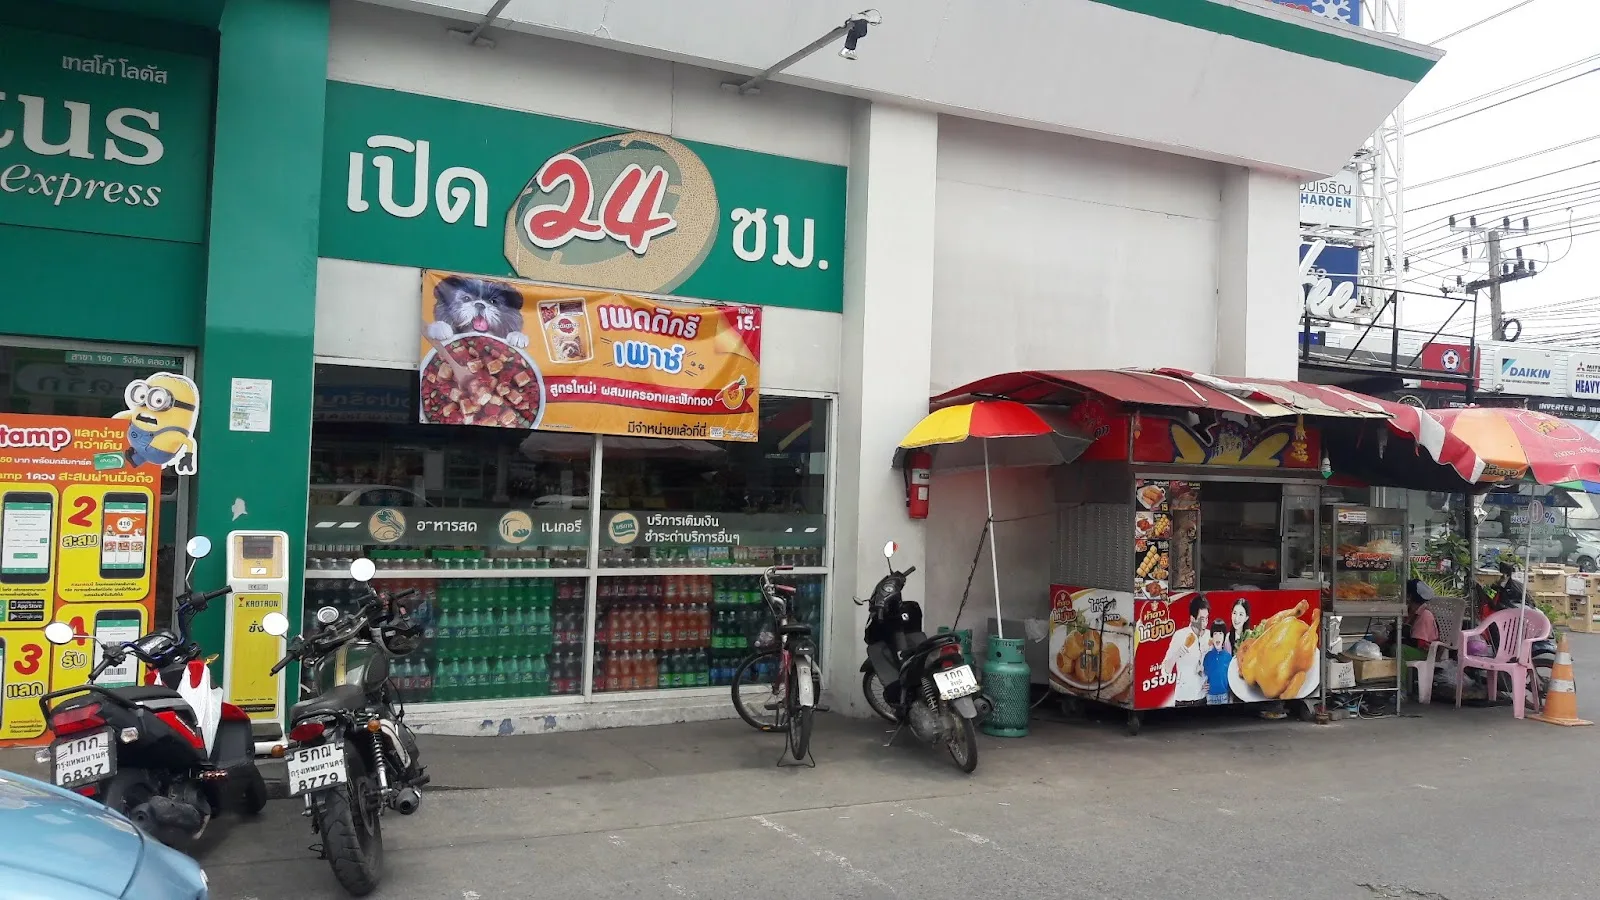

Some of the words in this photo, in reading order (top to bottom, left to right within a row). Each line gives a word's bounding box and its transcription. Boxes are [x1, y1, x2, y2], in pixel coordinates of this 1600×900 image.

[62, 54, 115, 77] เทสโก้
[119, 58, 168, 84] โลตัส
[0, 163, 162, 207] express
[347, 135, 489, 227] เปิด
[524, 153, 677, 254] 24
[730, 205, 829, 270] ชม.
[598, 305, 702, 341] เพดดิกรี
[71, 353, 93, 361] สาขา
[97, 354, 112, 363] 190
[1509, 367, 1551, 379] DAIKIN
[549, 380, 597, 398] สูตรใหม่!
[74, 427, 125, 439] แลกง่าย
[627, 421, 707, 438] มีจำหน่ายแล้วที่นี่
[73, 438, 123, 451] กว่าเดิม
[58, 471, 154, 484] สะสมผ่านมือถือ
[68, 495, 97, 528] 2
[646, 513, 720, 527] บริการเติมเงิน
[62, 534, 99, 548] สะสม
[1139, 620, 1175, 641] ไก่ย่าง
[14, 644, 43, 675] 3
[61, 650, 87, 669] รับ
[7, 682, 43, 698] แลก
[63, 763, 104, 784] 6837
[291, 758, 344, 778] กรุงเทพมหานคร
[298, 772, 339, 791] 8779
